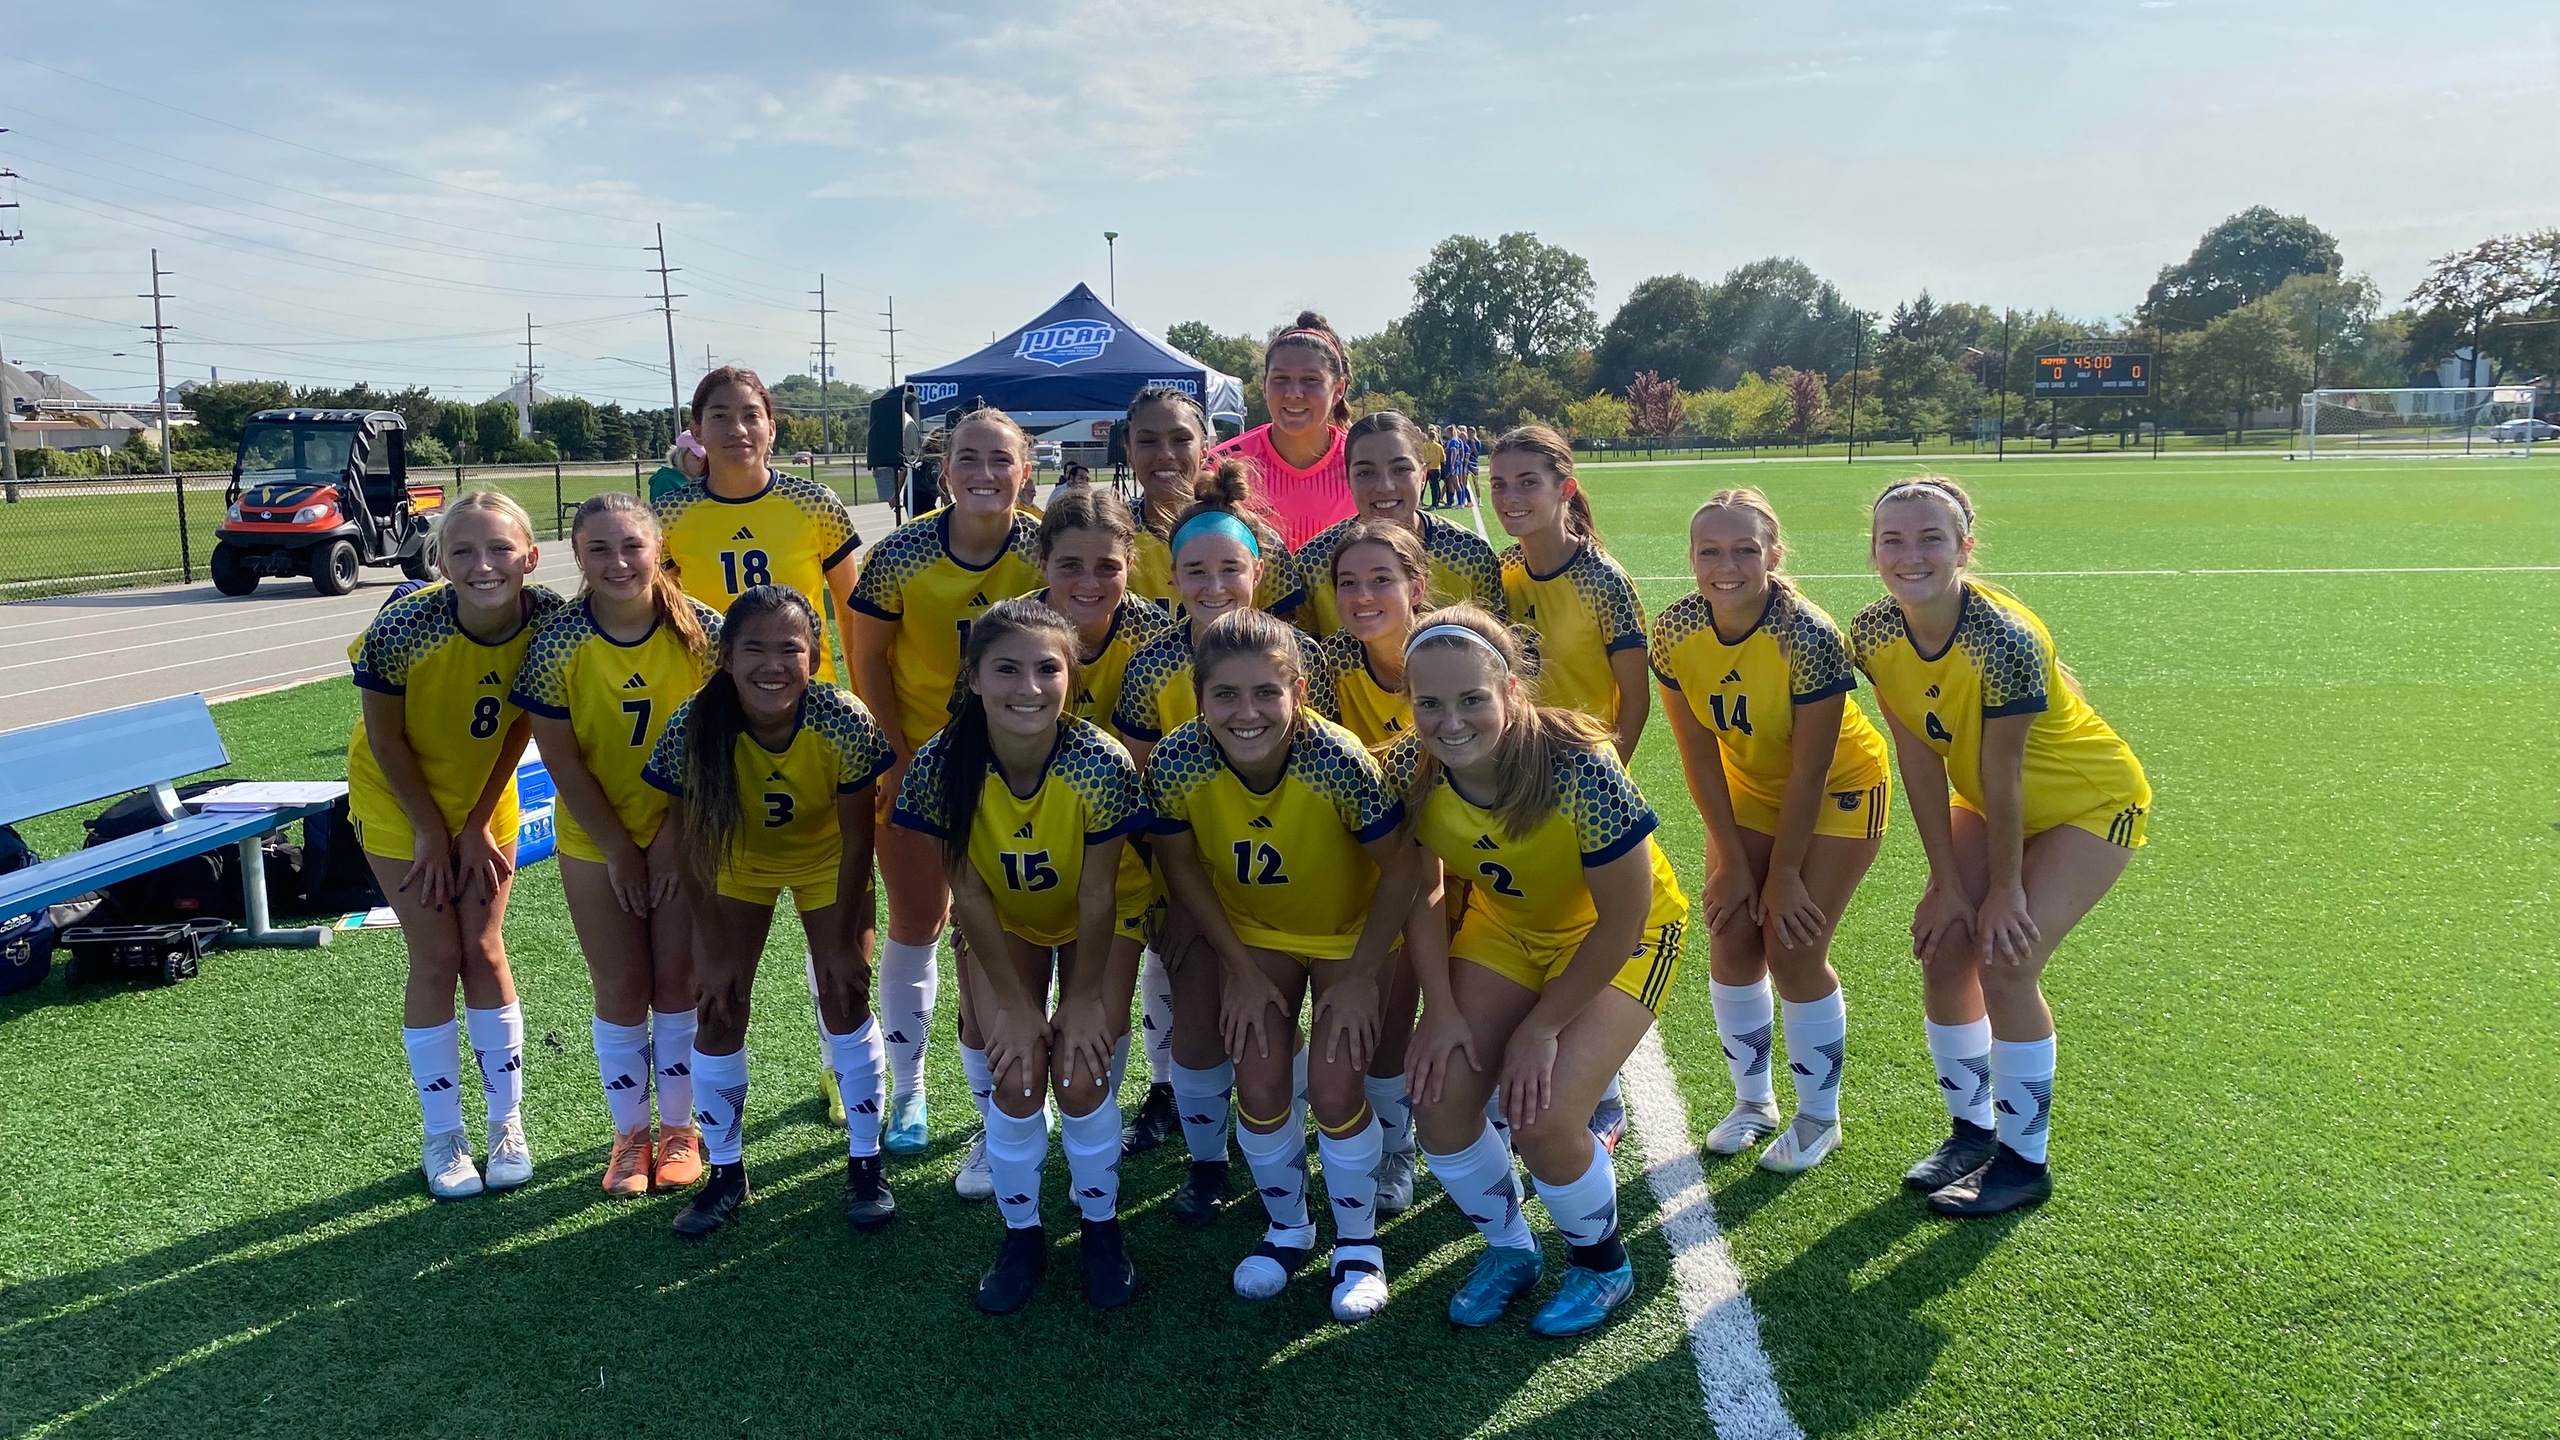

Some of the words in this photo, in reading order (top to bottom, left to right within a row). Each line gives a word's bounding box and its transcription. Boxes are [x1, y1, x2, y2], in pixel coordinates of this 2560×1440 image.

[1014, 327, 1116, 357] NJCAA
[2059, 339, 2127, 354] SKIPPERS
[2053, 367, 2062, 379] 0
[2074, 356, 2112, 369] 45:00
[2132, 366, 2141, 378] 0
[720, 549, 771, 595] 18
[470, 696, 501, 739] 8
[622, 698, 653, 747] 7
[1709, 692, 1754, 737] 14
[763, 792, 795, 829] 3
[999, 850, 1059, 893] 15
[1233, 839, 1289, 886] 12
[1478, 861, 1525, 899] 2
